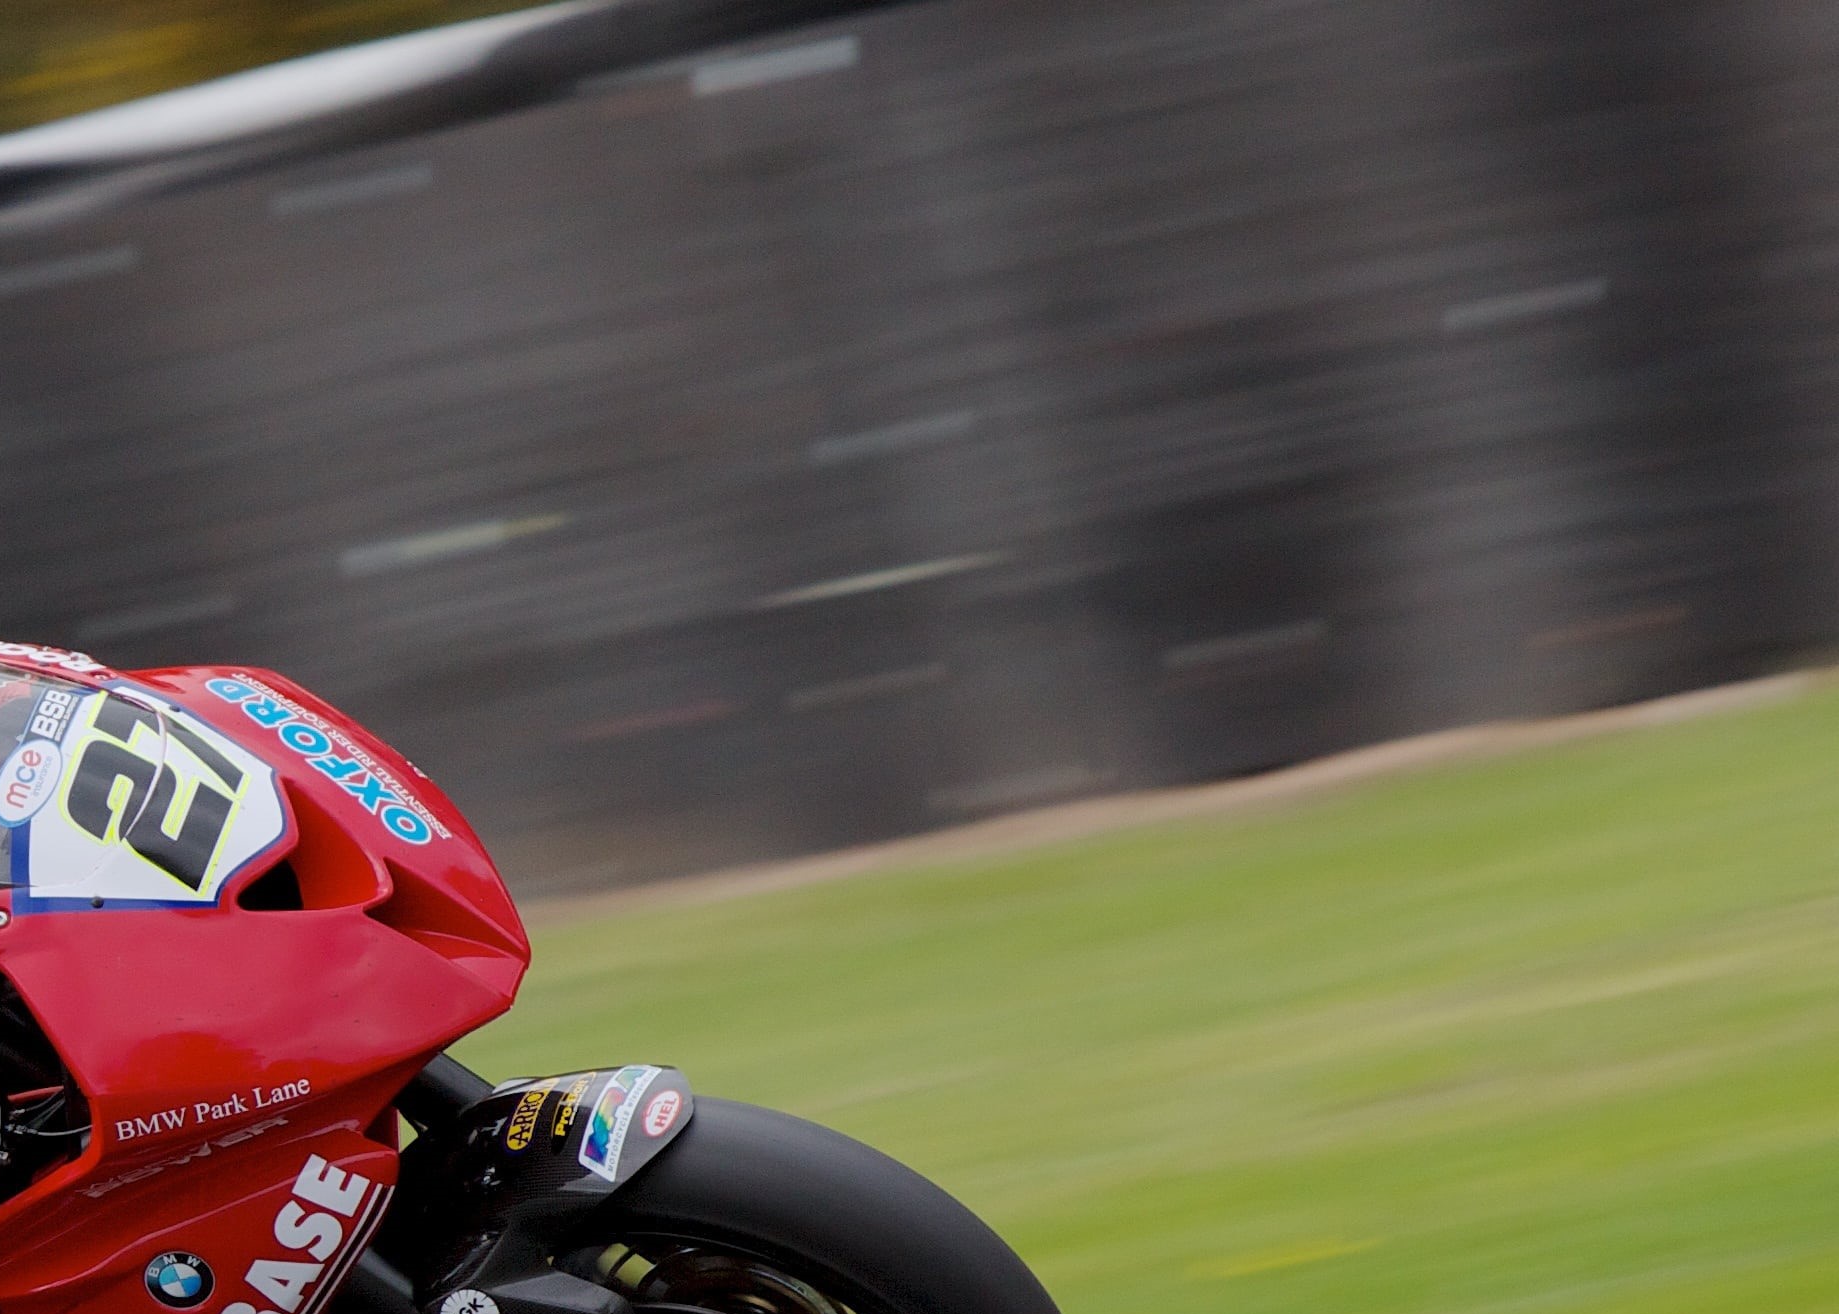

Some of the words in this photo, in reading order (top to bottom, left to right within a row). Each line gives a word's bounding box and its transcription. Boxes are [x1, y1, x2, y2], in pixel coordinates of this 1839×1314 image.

[31, 690, 72, 740] BSB
[231, 671, 328, 729] EQUIPMENT
[3, 747, 43, 808] mce
[205, 677, 431, 845] OXFORD
[328, 729, 376, 767] RIDER
[59, 690, 252, 900] 27
[373, 767, 453, 840] ESSENTIAL
[116, 1107, 187, 1142] BMW
[196, 1093, 249, 1126] Park
[254, 1077, 312, 1109] Lane
[654, 1098, 678, 1128] HEL
[147, 1253, 201, 1279] BMW
